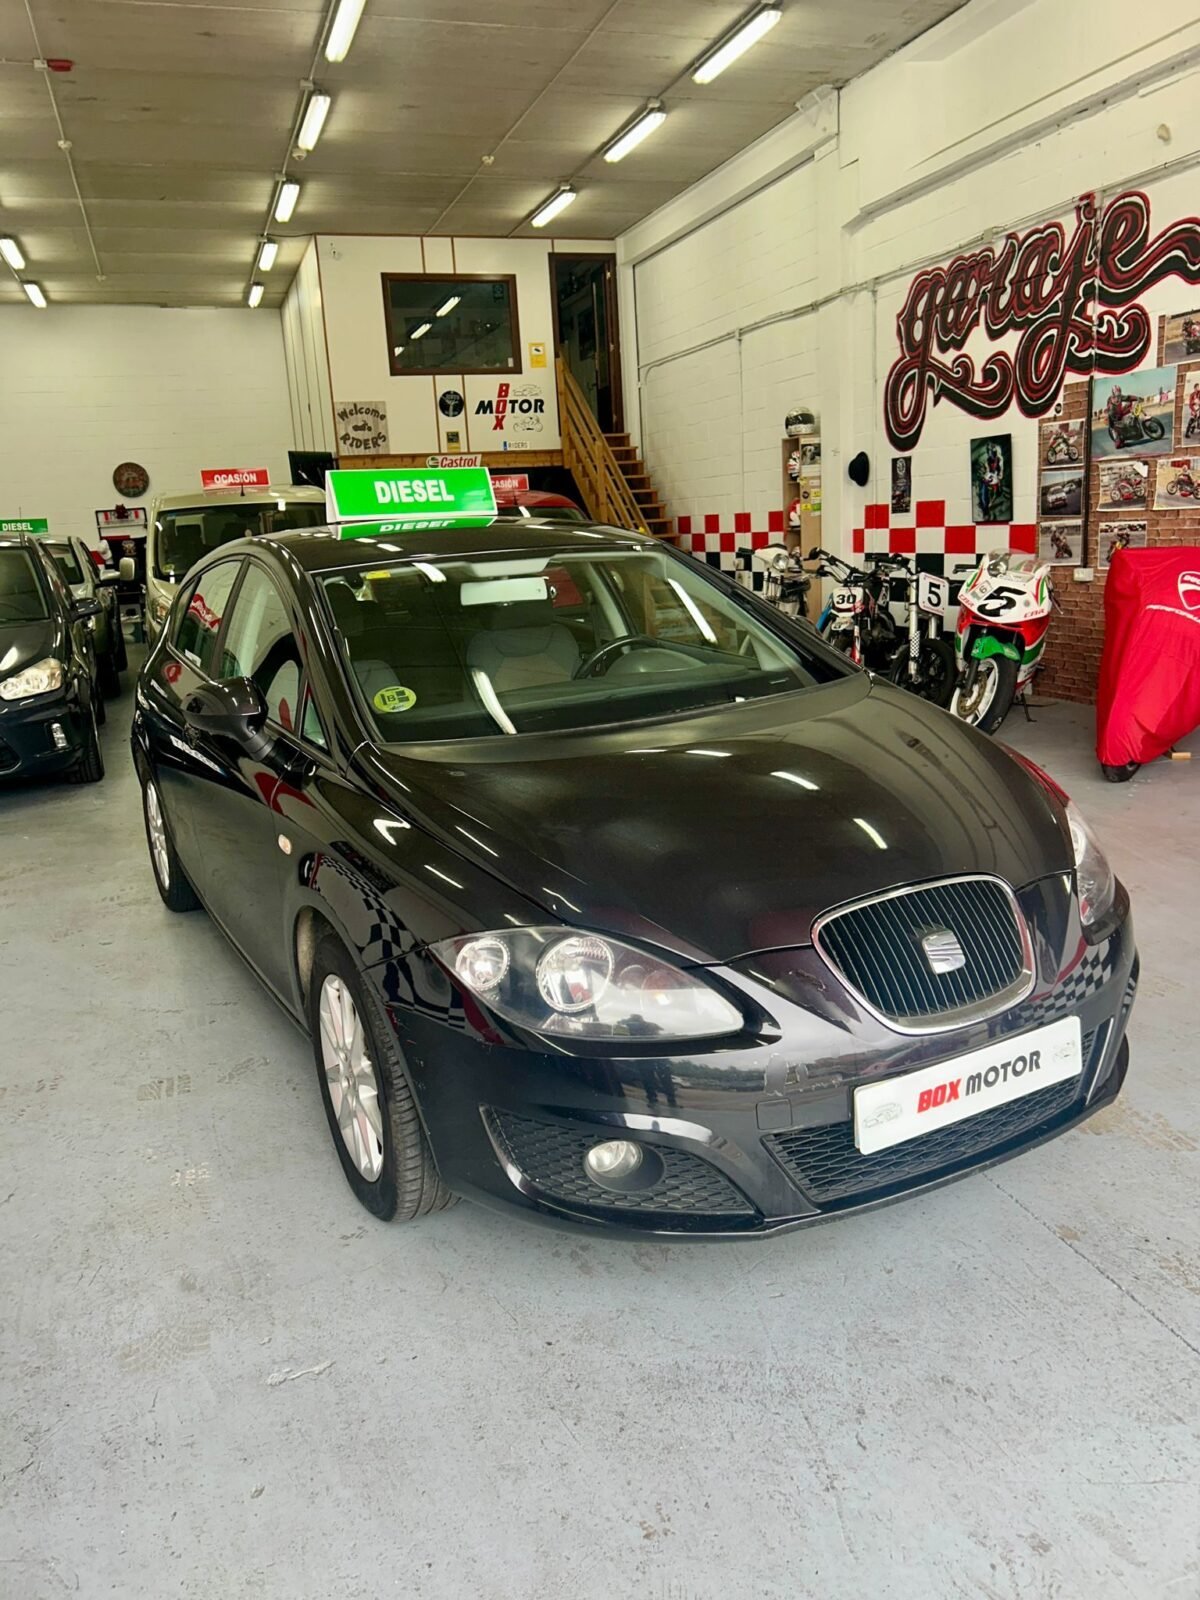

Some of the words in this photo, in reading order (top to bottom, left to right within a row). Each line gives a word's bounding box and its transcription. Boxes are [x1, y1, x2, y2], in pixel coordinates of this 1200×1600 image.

[884, 190, 1200, 451] garaje
[337, 403, 386, 421] Welcome
[340, 432, 386, 450] RIDERS
[440, 456, 478, 468] Castrol
[214, 471, 257, 484] OCASIÓN
[490, 477, 519, 488] CASIÓN
[373, 479, 455, 504] DIESEL
[2, 522, 33, 532] DIESEL
[836, 593, 858, 605] 30
[927, 581, 941, 607] 5
[977, 586, 1027, 617] 5
[917, 1078, 961, 1113] BOX
[965, 1050, 1042, 1097] MOTOR
